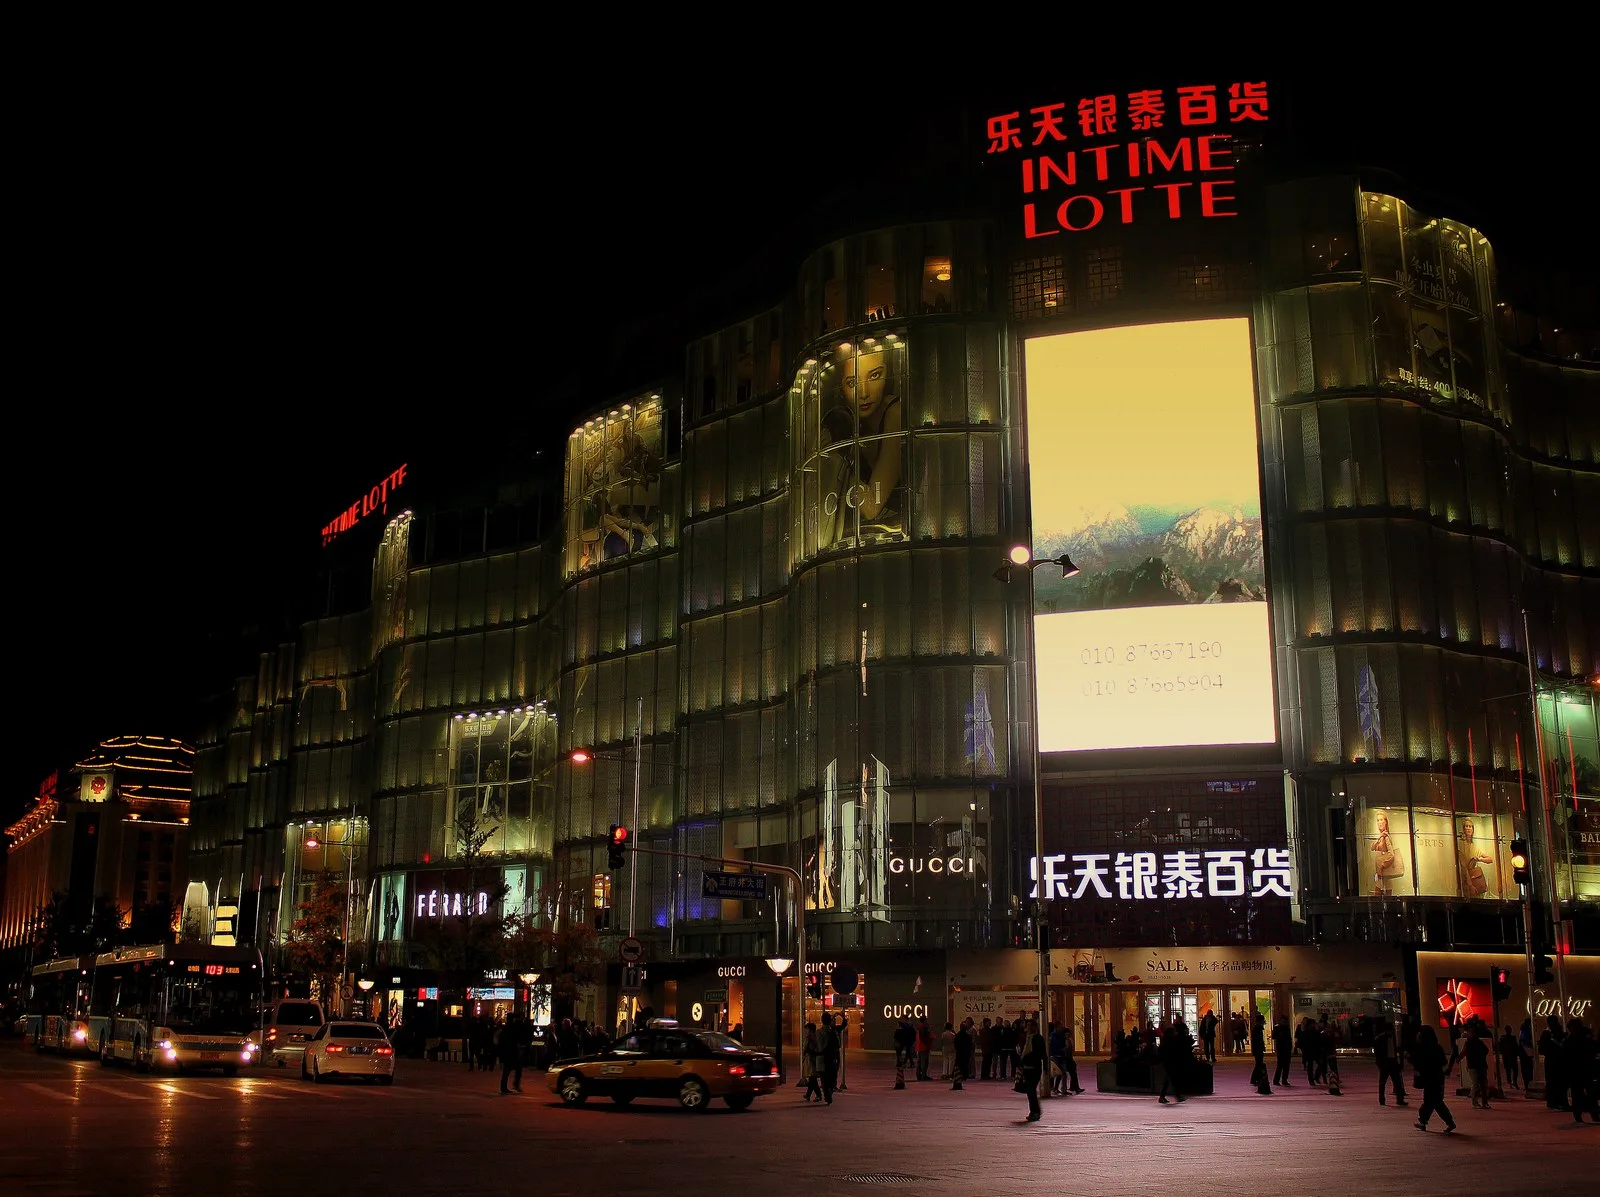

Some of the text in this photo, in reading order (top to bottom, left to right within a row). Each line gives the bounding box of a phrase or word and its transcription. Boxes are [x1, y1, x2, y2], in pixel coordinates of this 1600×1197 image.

[987, 81, 1269, 153] 乐天银泰百货
[1022, 135, 1235, 193] INTIME
[1022, 180, 1239, 239] LOTTE
[1080, 646, 1115, 665] 010
[889, 857, 974, 873] GUCCI
[1029, 848, 1295, 900] 乐天银泰百货
[205, 965, 224, 975] 103
[717, 966, 746, 977] GUCCI
[1146, 959, 1185, 972] SALE
[883, 1004, 928, 1019] GUCCI
[965, 1003, 995, 1013] SALE
